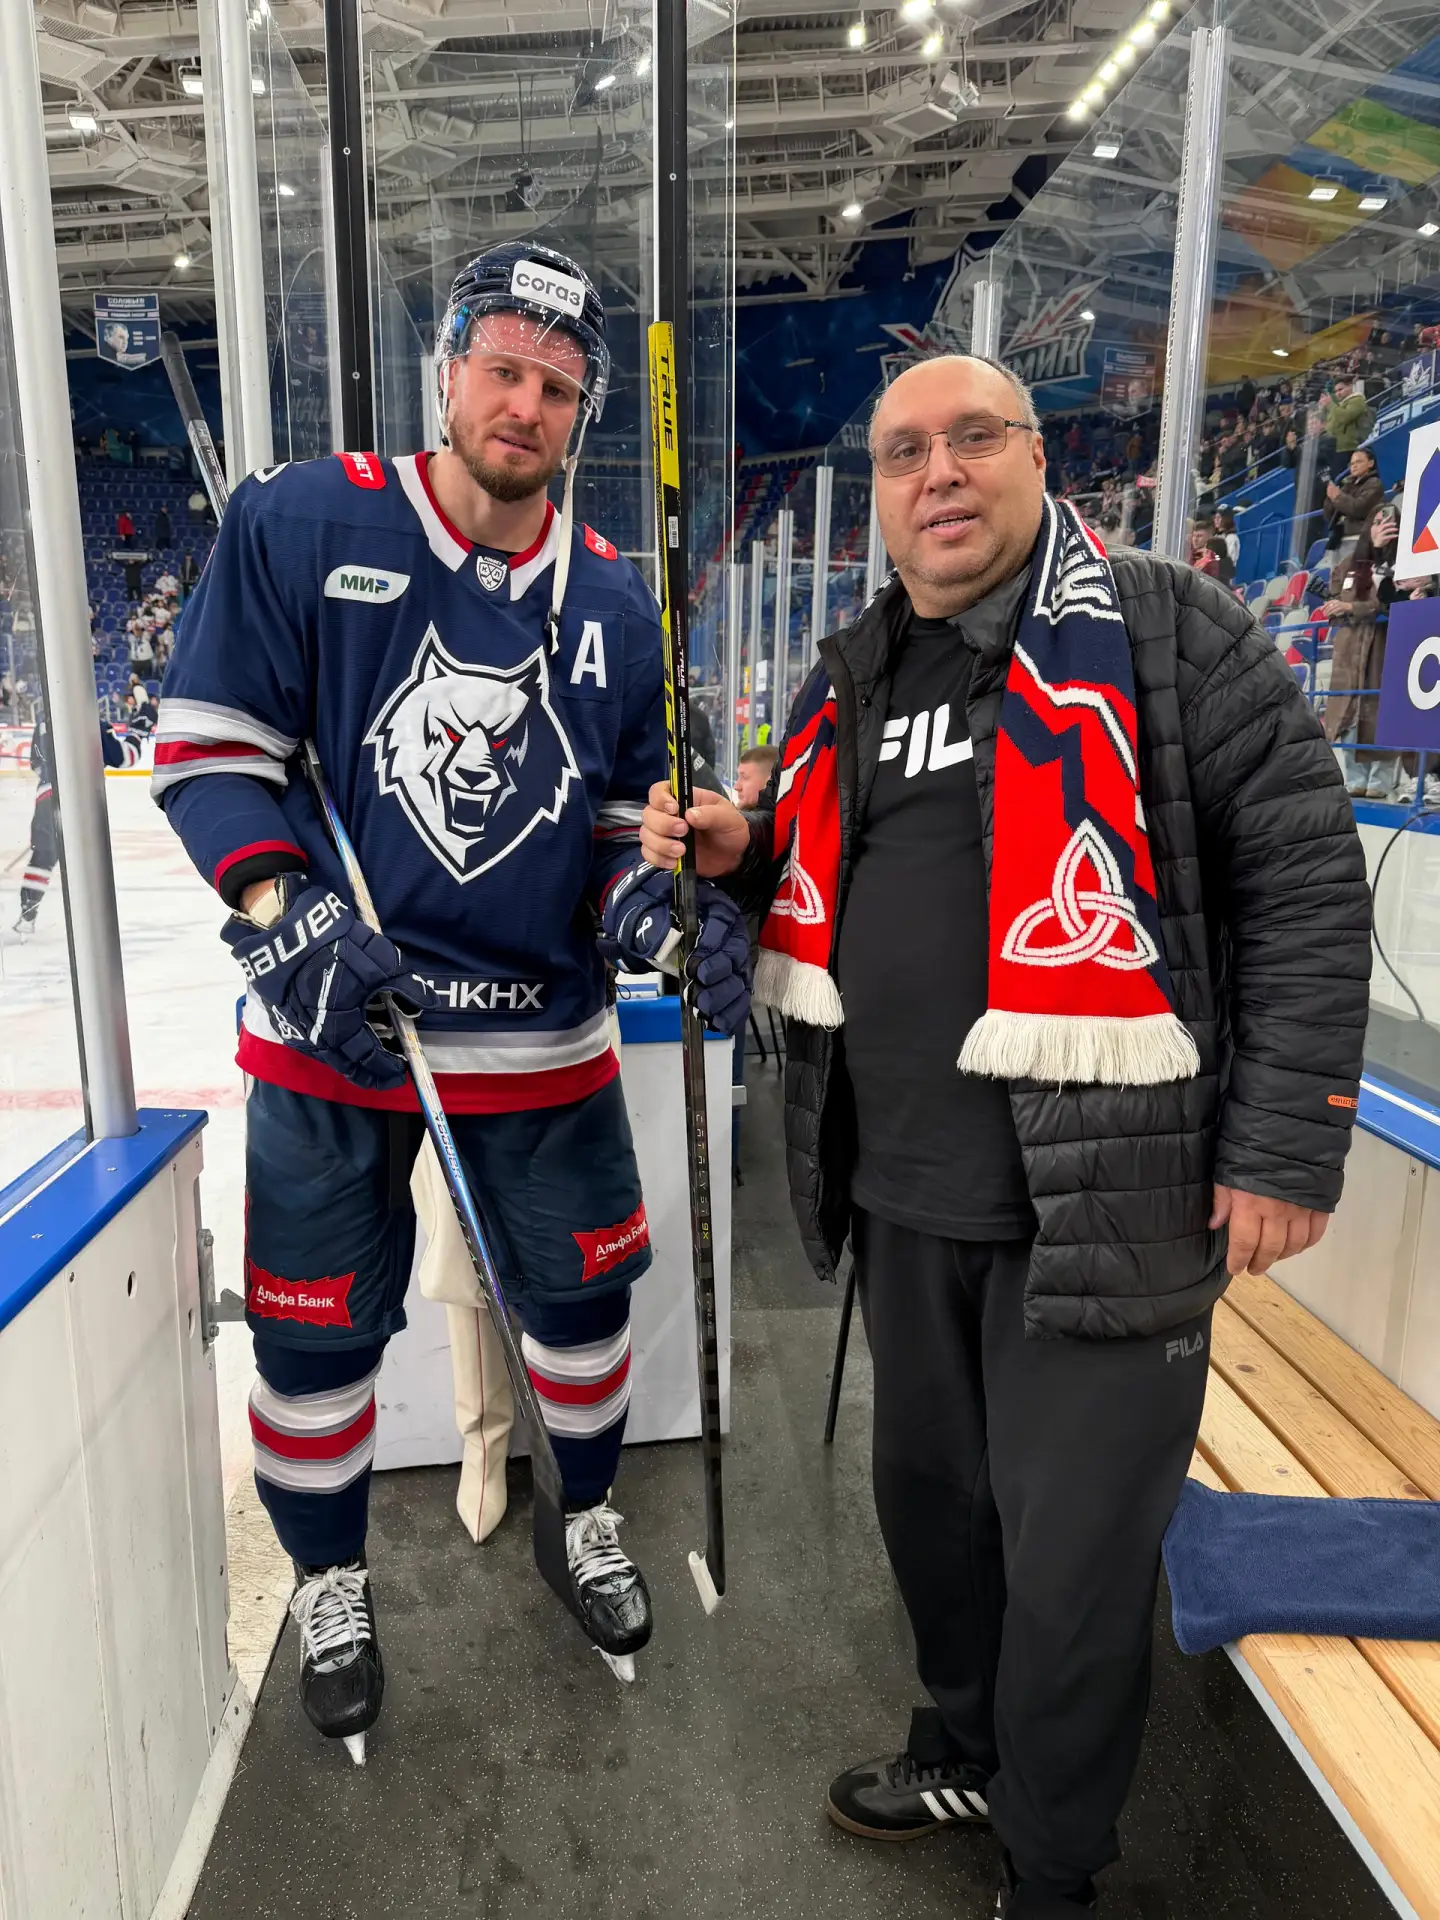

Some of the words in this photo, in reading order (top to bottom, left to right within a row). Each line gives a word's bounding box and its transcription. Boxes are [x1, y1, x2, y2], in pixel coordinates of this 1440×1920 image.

[516, 273, 581, 306] согаз
[661, 349, 673, 451] TRUE
[340, 573, 390, 594] МИР
[879, 703, 974, 778] FIL
[696, 1113, 708, 1214] CATALYST
[701, 1222, 709, 1240] 9X
[596, 1234, 632, 1262] Альфа
[257, 1284, 296, 1308] Альфа
[298, 1294, 335, 1308] Банк
[1165, 1331, 1204, 1363] FILA
